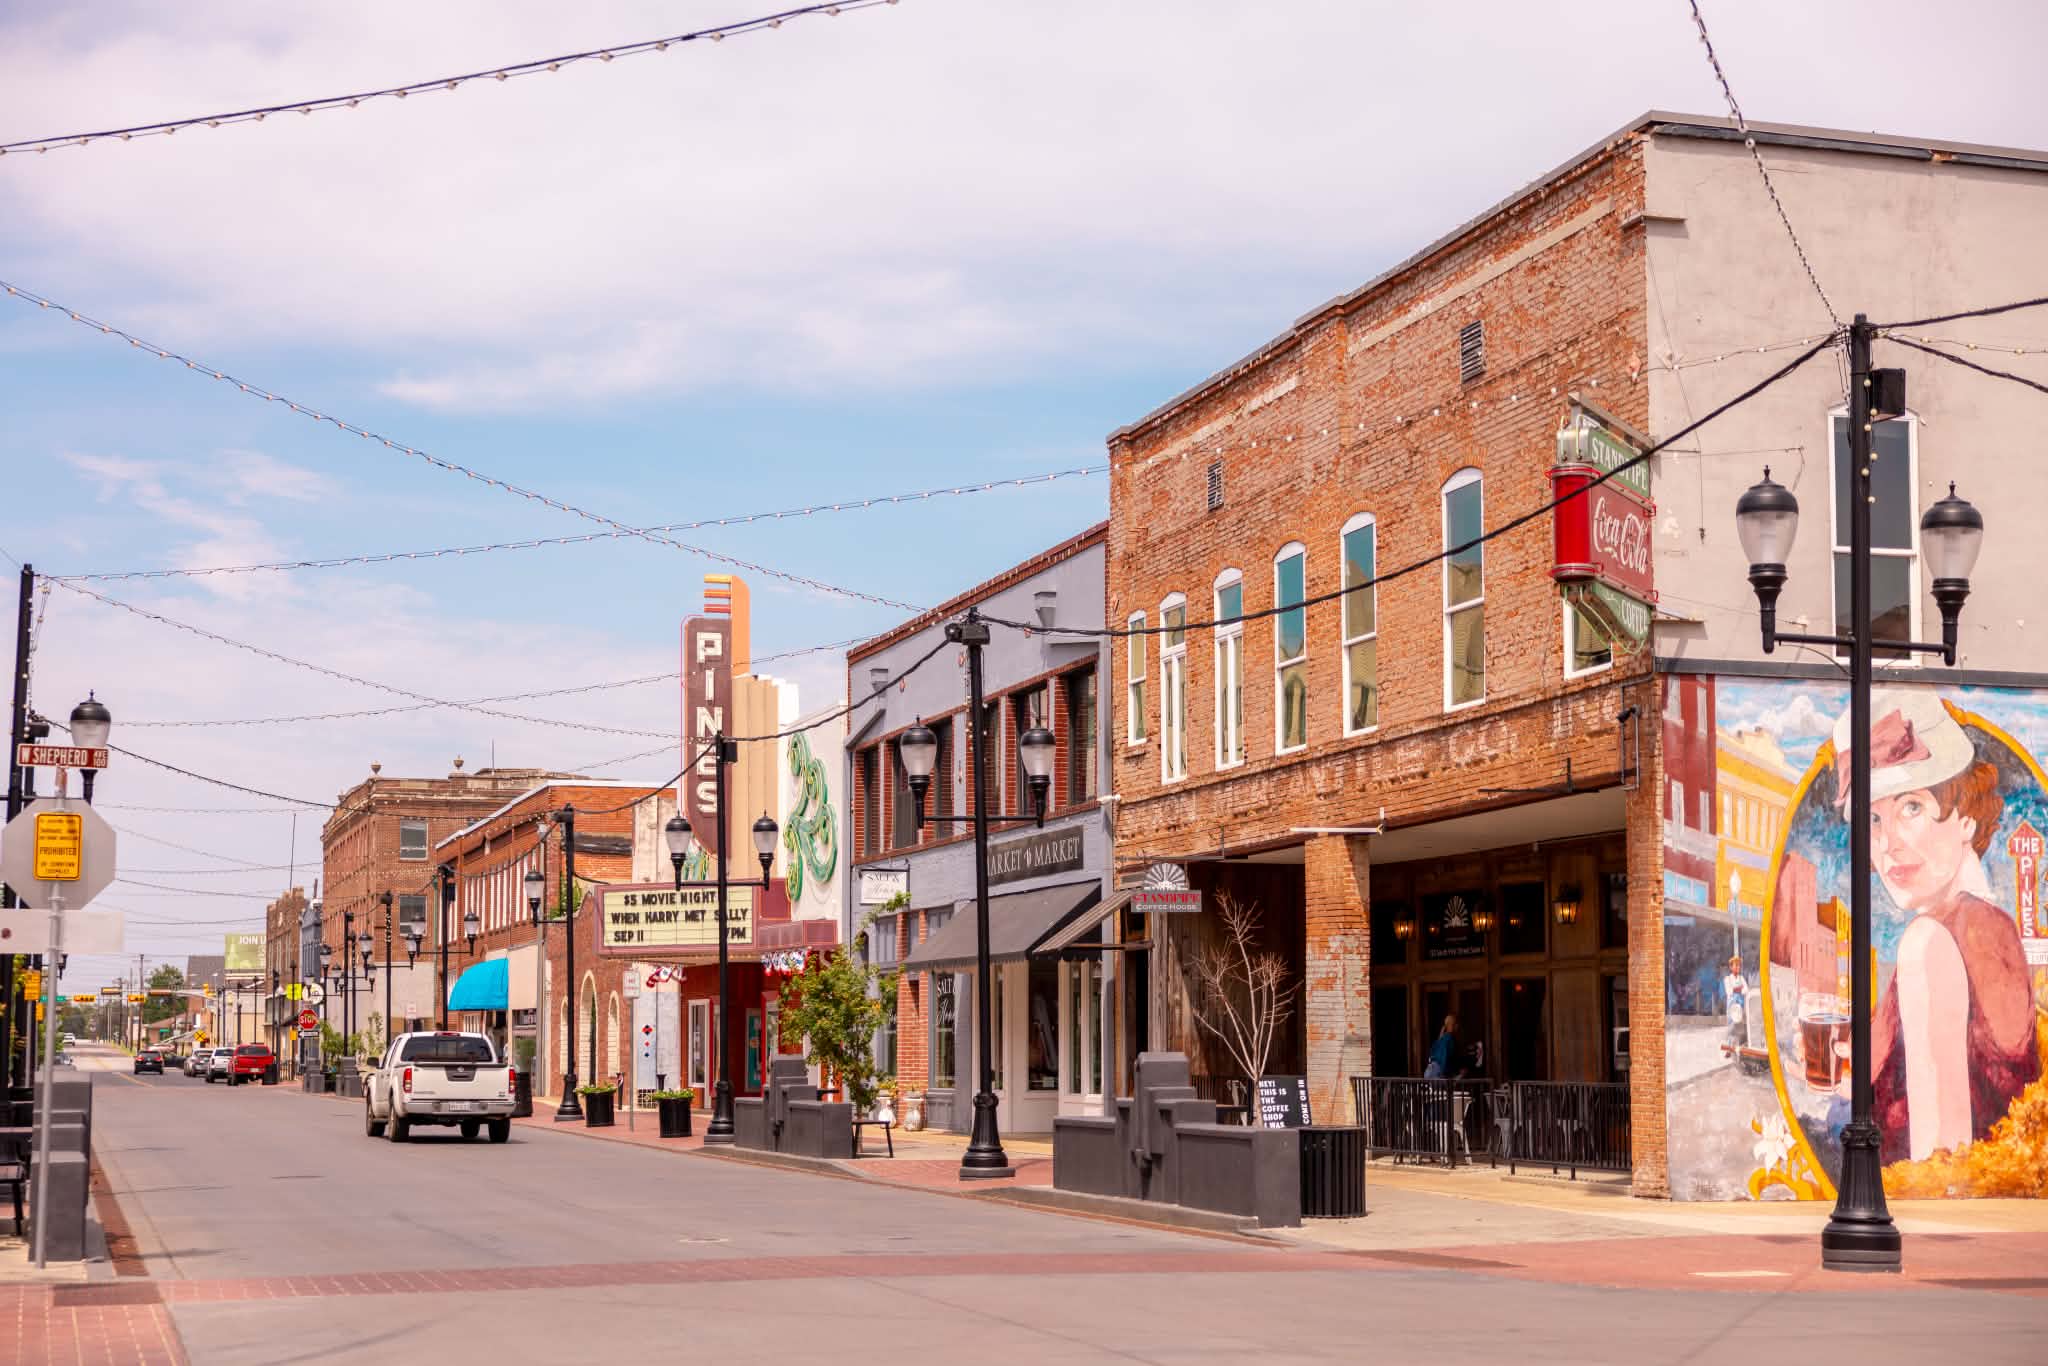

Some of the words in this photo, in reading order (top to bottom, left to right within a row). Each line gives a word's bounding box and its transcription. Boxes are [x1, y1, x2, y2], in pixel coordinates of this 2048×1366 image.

[696, 632, 722, 813] PINES
[21, 747, 31, 763] W
[32, 747, 88, 766] SHEPHERD
[2013, 837, 2040, 854] THE
[987, 849, 1022, 877] ARKET
[1034, 835, 1080, 867] MARKET
[624, 894, 637, 906] $5
[642, 892, 676, 905] MOVIE
[680, 891, 716, 903] NIGHT
[2021, 857, 2033, 937] PINES
[611, 912, 640, 924] WHEN
[645, 910, 680, 923] HARRY
[685, 909, 706, 922] MET
[714, 908, 748, 922] SLLY
[240, 935, 258, 945] JOIN
[614, 930, 634, 942] SEP
[1259, 1080, 1276, 1088] HEY!
[1279, 1088, 1287, 1096] IS
[1300, 1090, 1306, 1101] ON
[1261, 1097, 1275, 1105] THE
[1262, 1104, 1289, 1112] COFFEE
[1301, 1103, 1310, 1125] COME
[1263, 1113, 1284, 1121] SHOP
